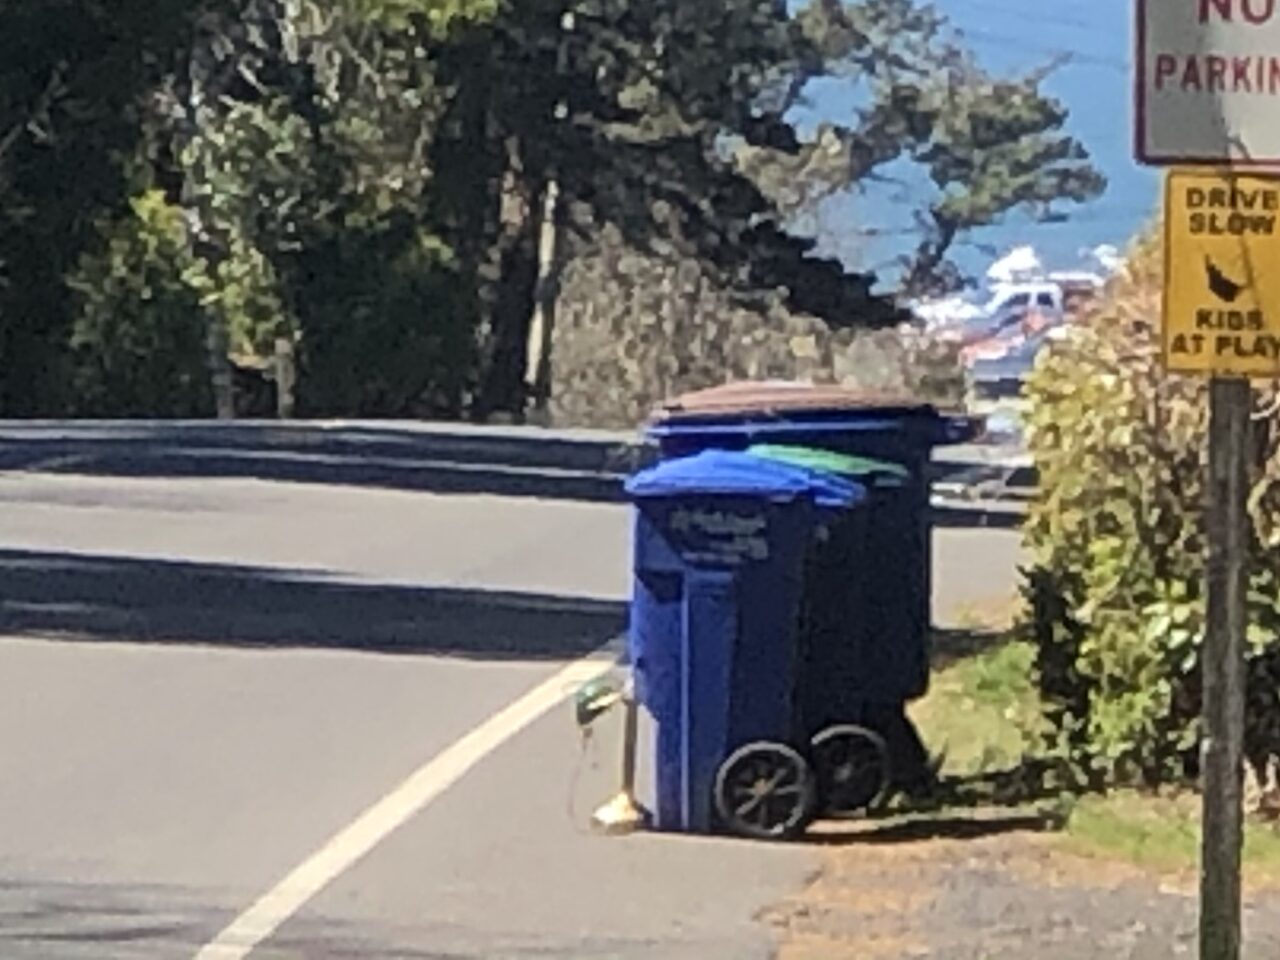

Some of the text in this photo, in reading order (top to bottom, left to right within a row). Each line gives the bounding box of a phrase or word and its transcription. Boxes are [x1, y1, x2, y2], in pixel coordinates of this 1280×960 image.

[1186, 187, 1279, 211] DRIVE
[1189, 212, 1275, 236] SLOW
[1196, 308, 1264, 332] KIDS
[1170, 332, 1205, 355] AT
